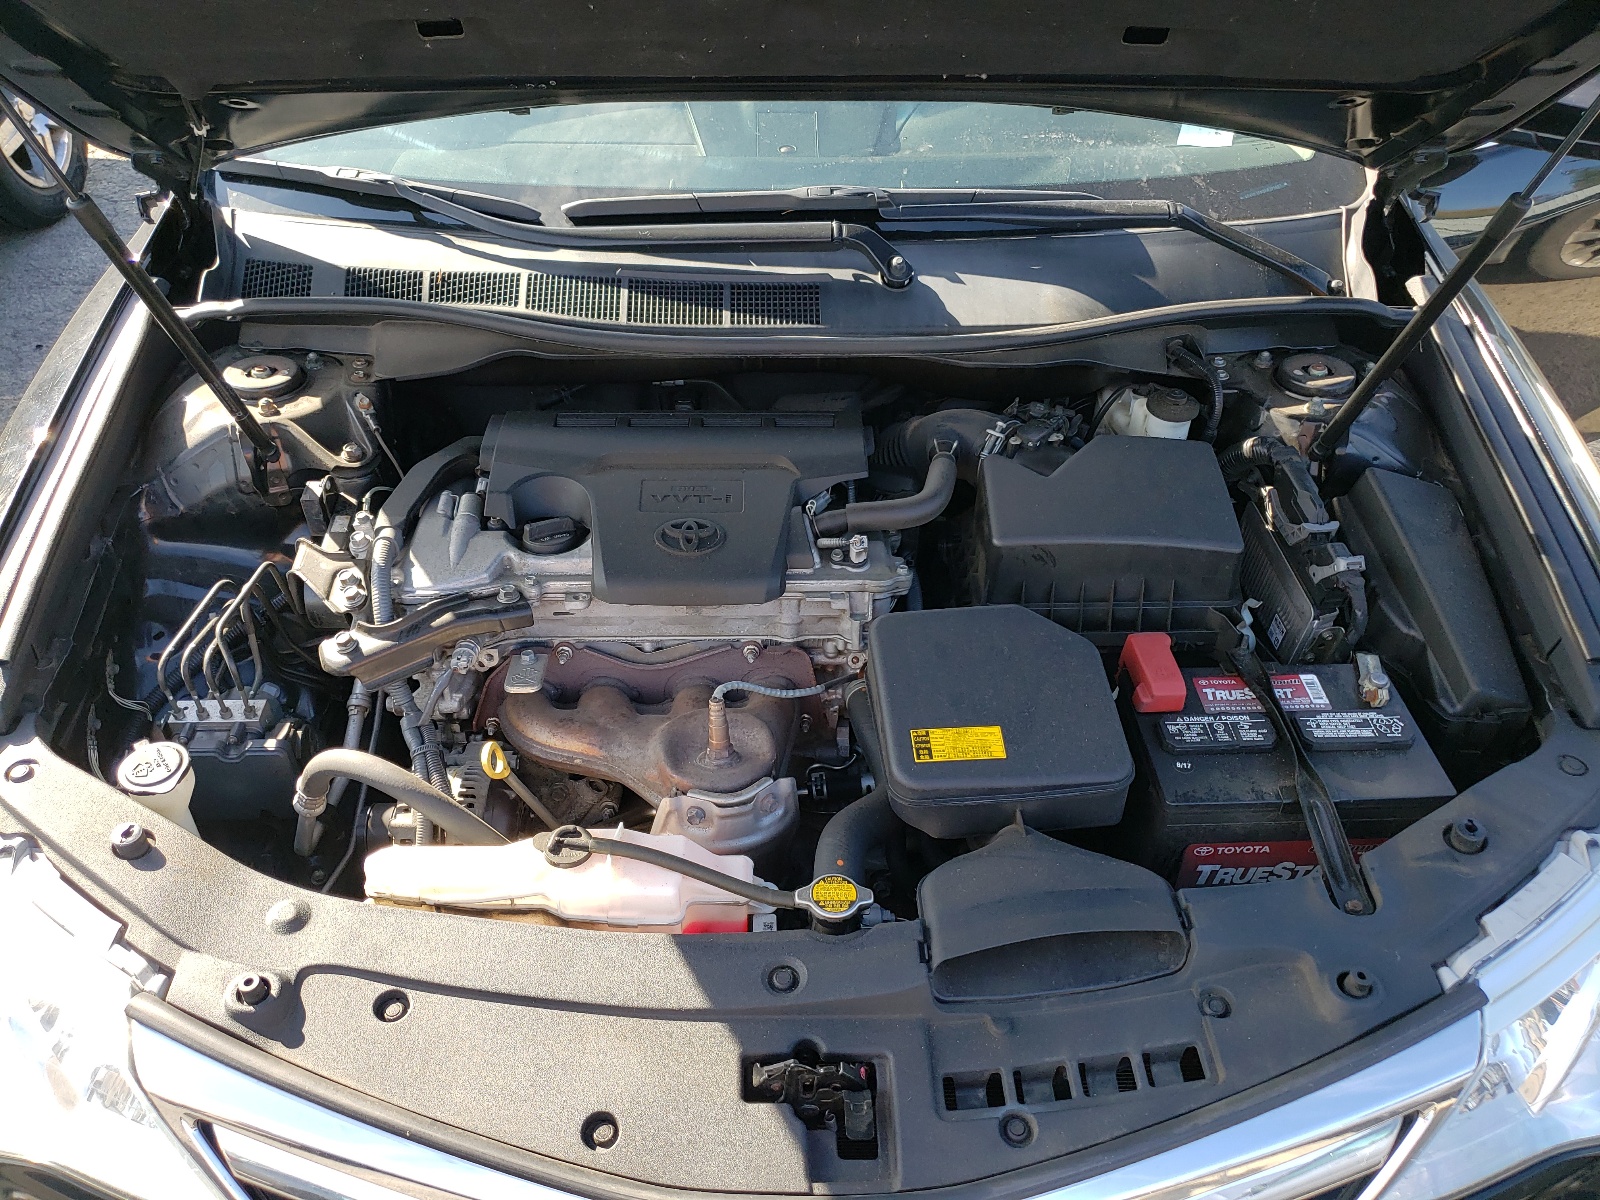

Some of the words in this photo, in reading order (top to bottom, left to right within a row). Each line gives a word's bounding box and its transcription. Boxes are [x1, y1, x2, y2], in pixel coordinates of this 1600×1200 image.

[650, 494, 732, 504] VVT-i
[1202, 687, 1296, 701] TRUESRT
[1217, 846, 1270, 855] TOYOTA
[1195, 862, 1323, 885] TRUEST
